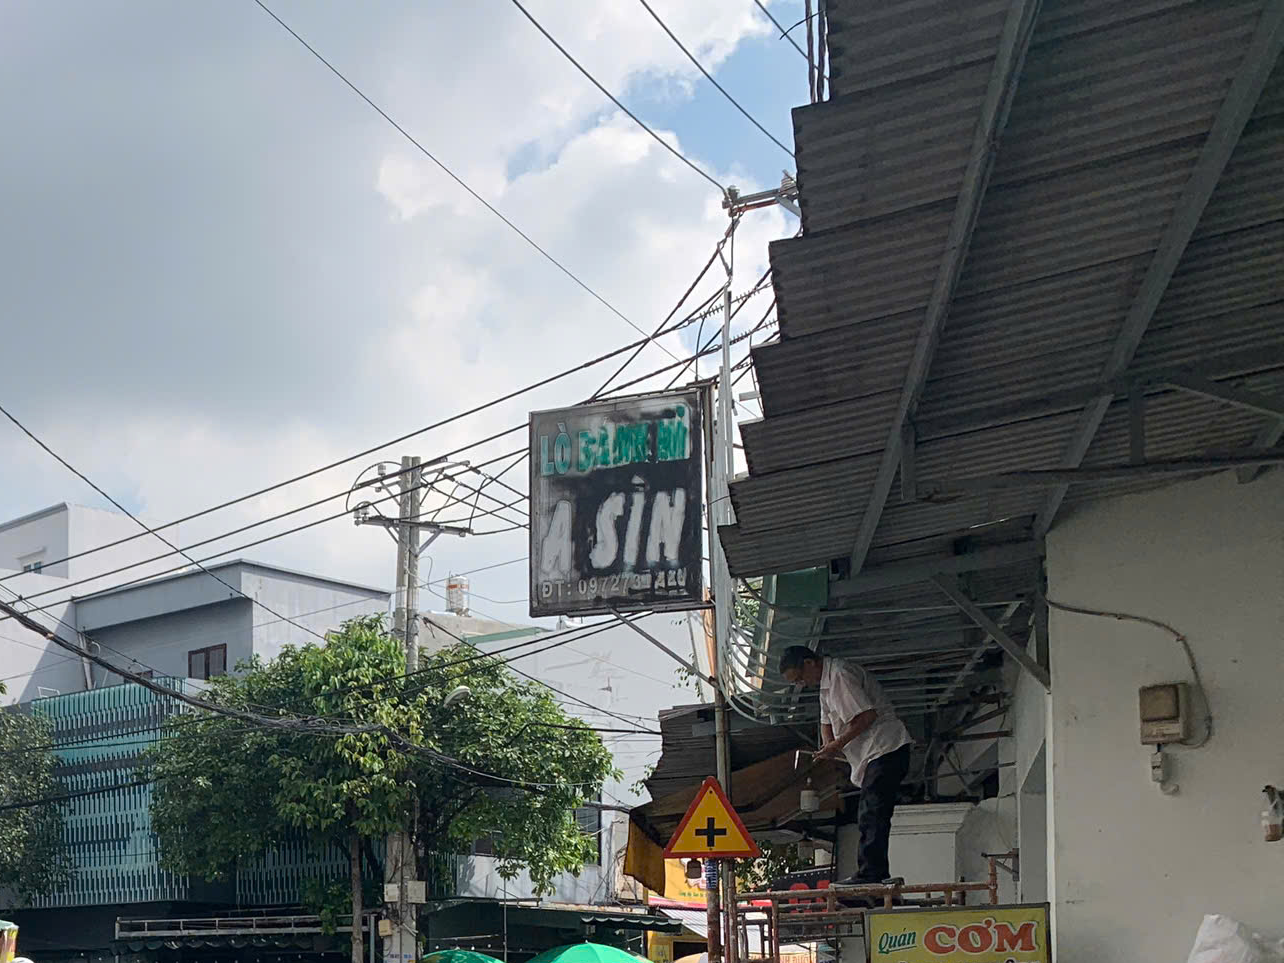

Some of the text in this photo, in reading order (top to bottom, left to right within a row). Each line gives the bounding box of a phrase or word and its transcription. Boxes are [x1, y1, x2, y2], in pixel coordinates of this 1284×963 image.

[540, 422, 573, 476] LÒ
[878, 919, 1037, 955] Quán CƠM
